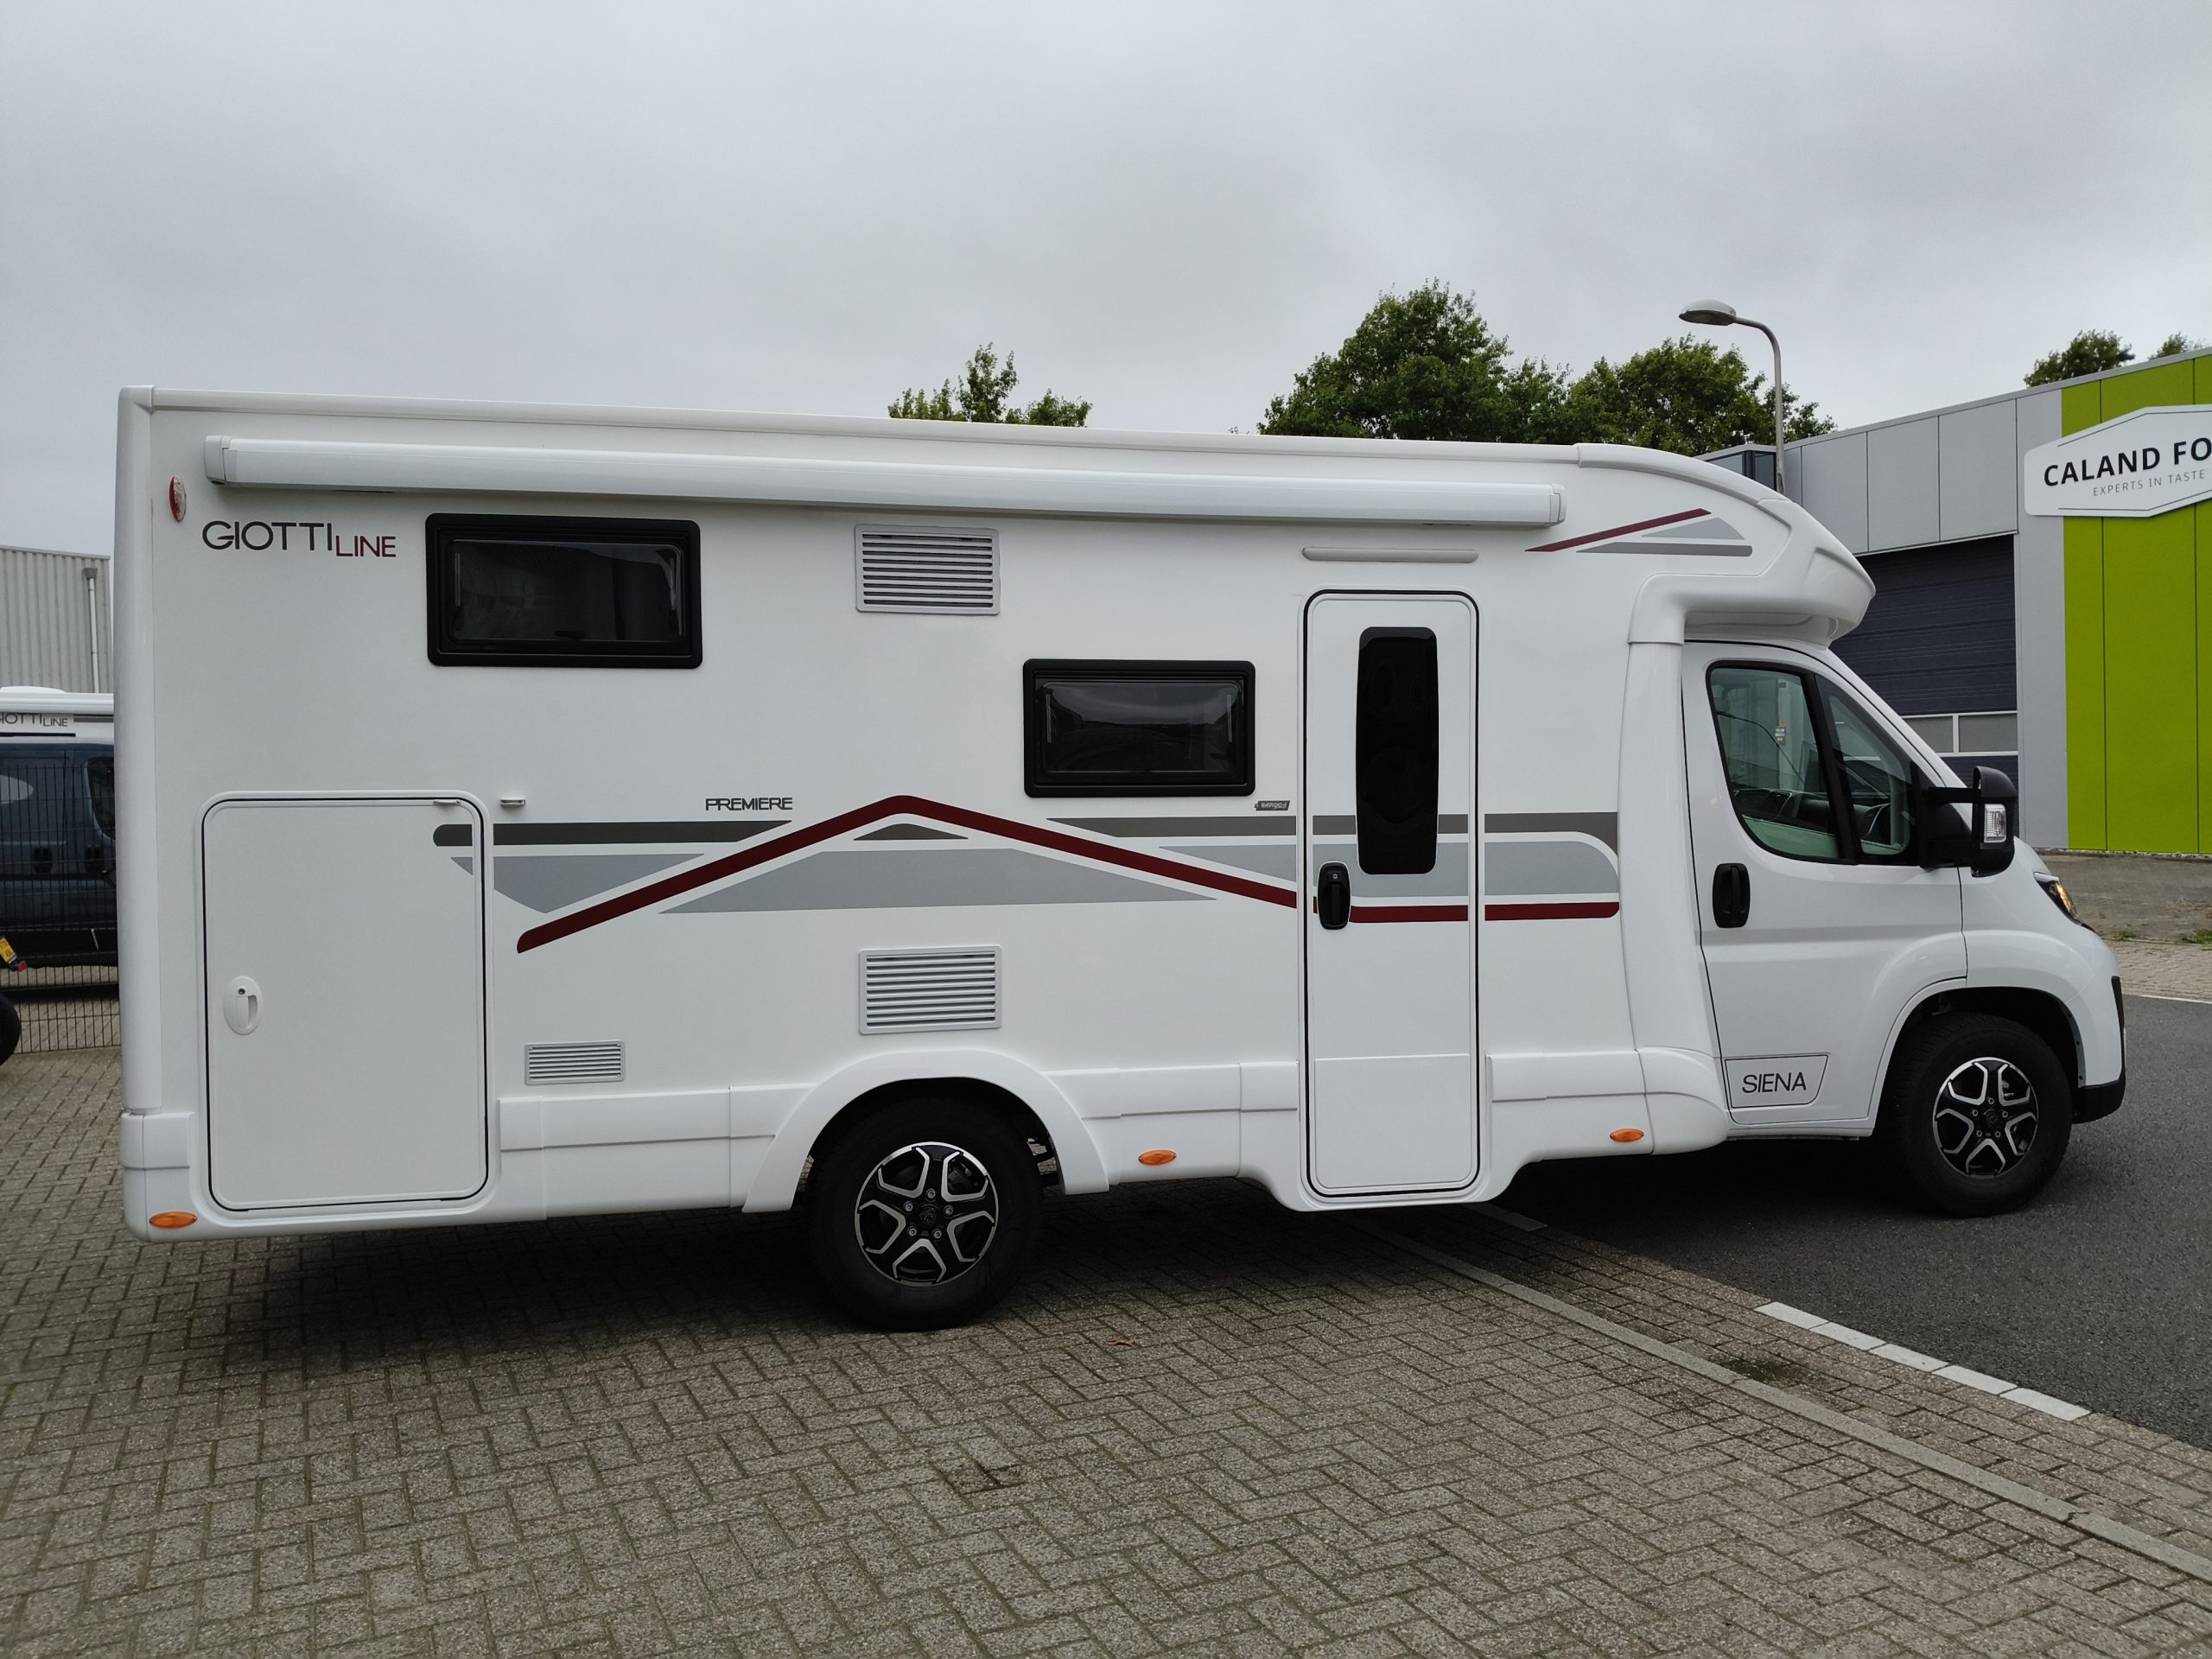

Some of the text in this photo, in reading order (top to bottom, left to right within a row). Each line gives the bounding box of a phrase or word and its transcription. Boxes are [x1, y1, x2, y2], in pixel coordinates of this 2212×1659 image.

[2044, 447, 2160, 486] CALAND
[2093, 469, 2206, 497] EXPERTS IN TASTE
[705, 797, 793, 810] PREMIERE
[1742, 1071, 1807, 1094] SIENA
